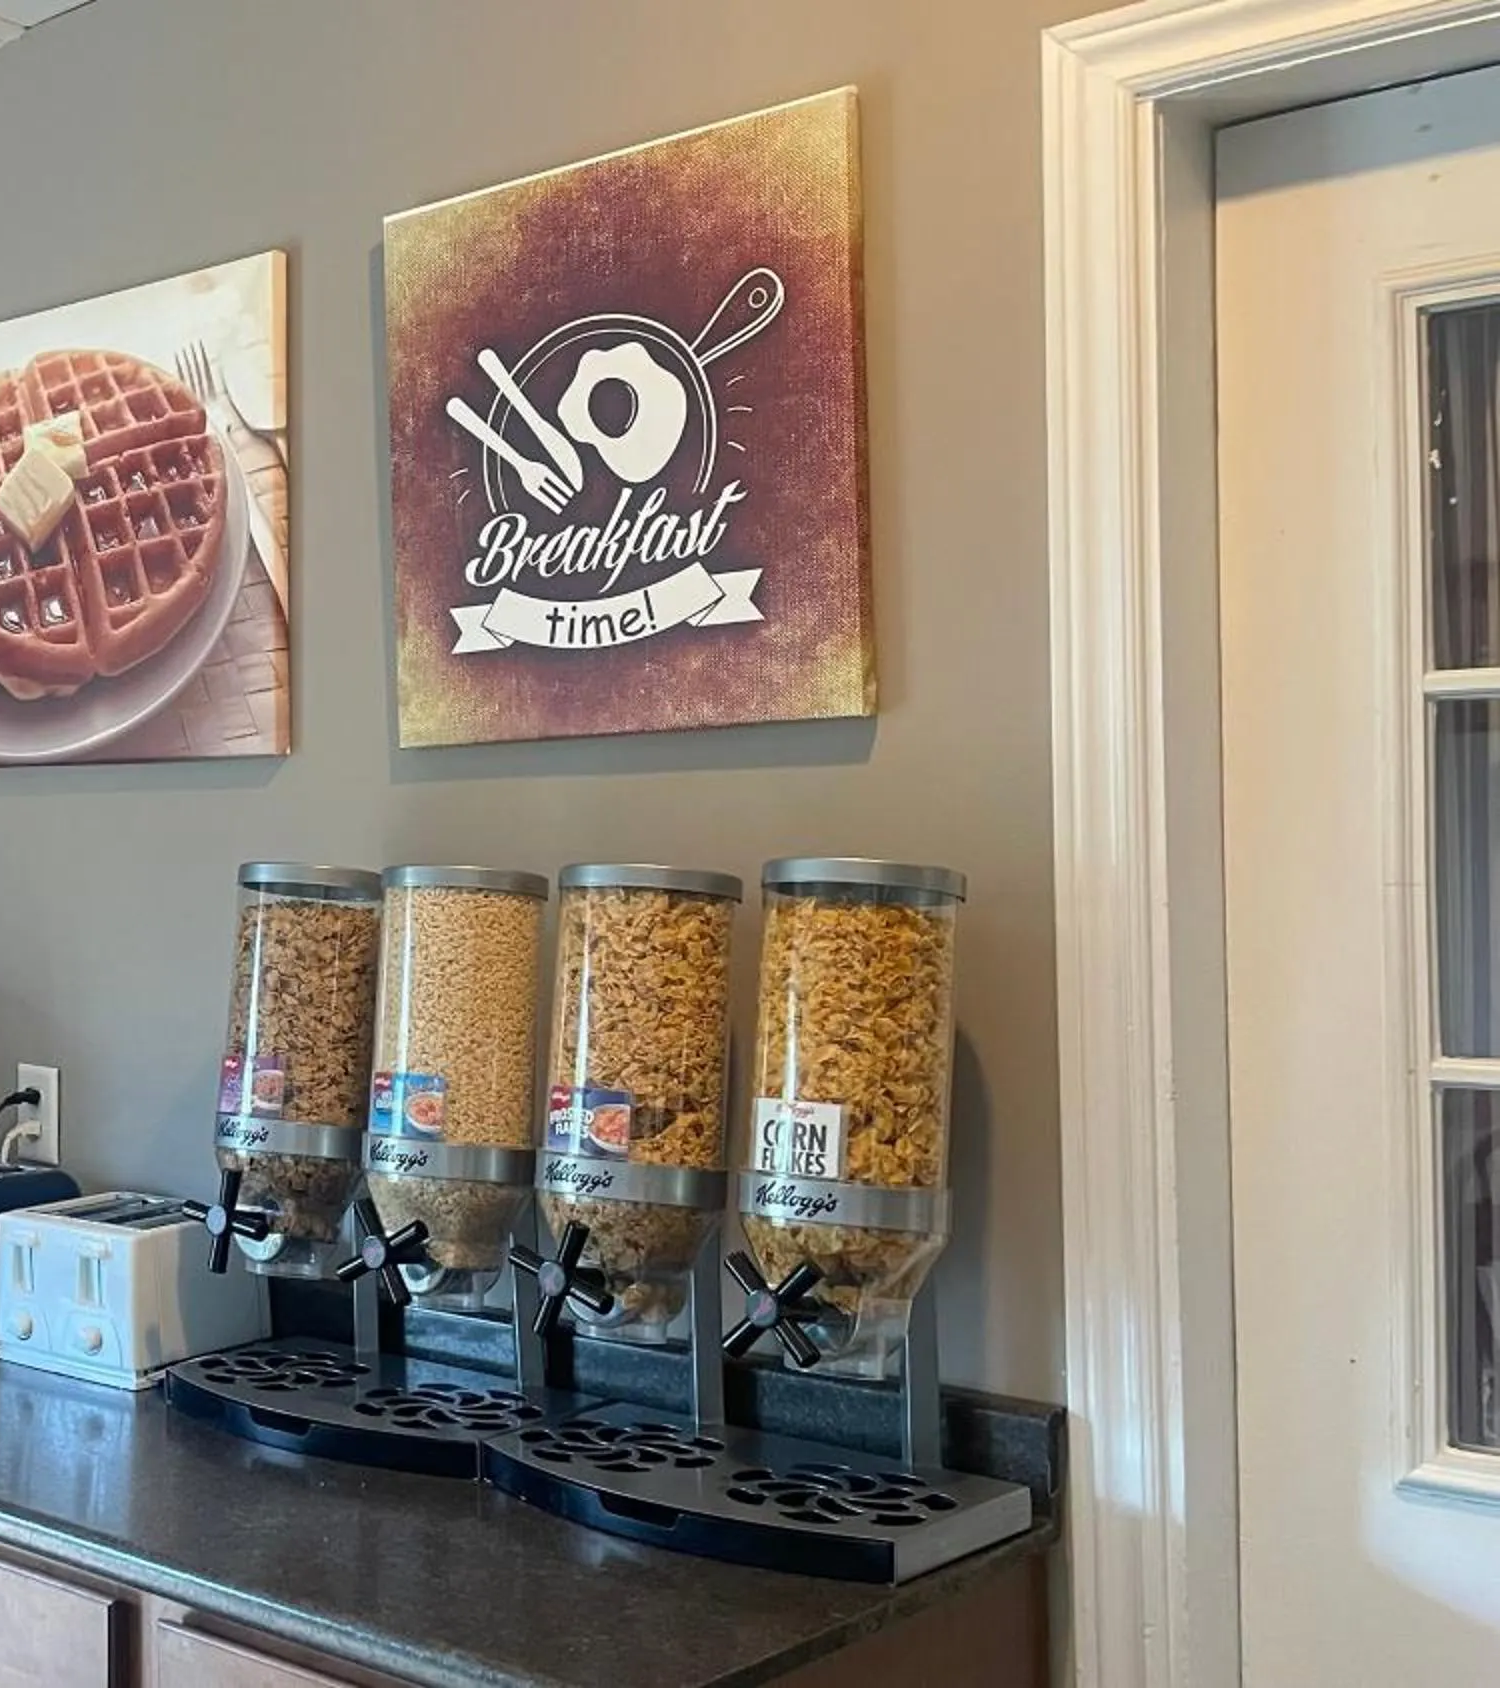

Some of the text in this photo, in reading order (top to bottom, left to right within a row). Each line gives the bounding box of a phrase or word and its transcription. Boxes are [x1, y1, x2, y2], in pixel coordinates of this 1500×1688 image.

[465, 480, 748, 593] Breakfast
[546, 589, 657, 645] time!
[763, 1119, 828, 1153] CORN
[371, 1139, 429, 1172] Kellogg's
[761, 1147, 827, 1176] FLKES
[545, 1159, 616, 1193] Kellogg's
[755, 1180, 839, 1218] Kellogg's
